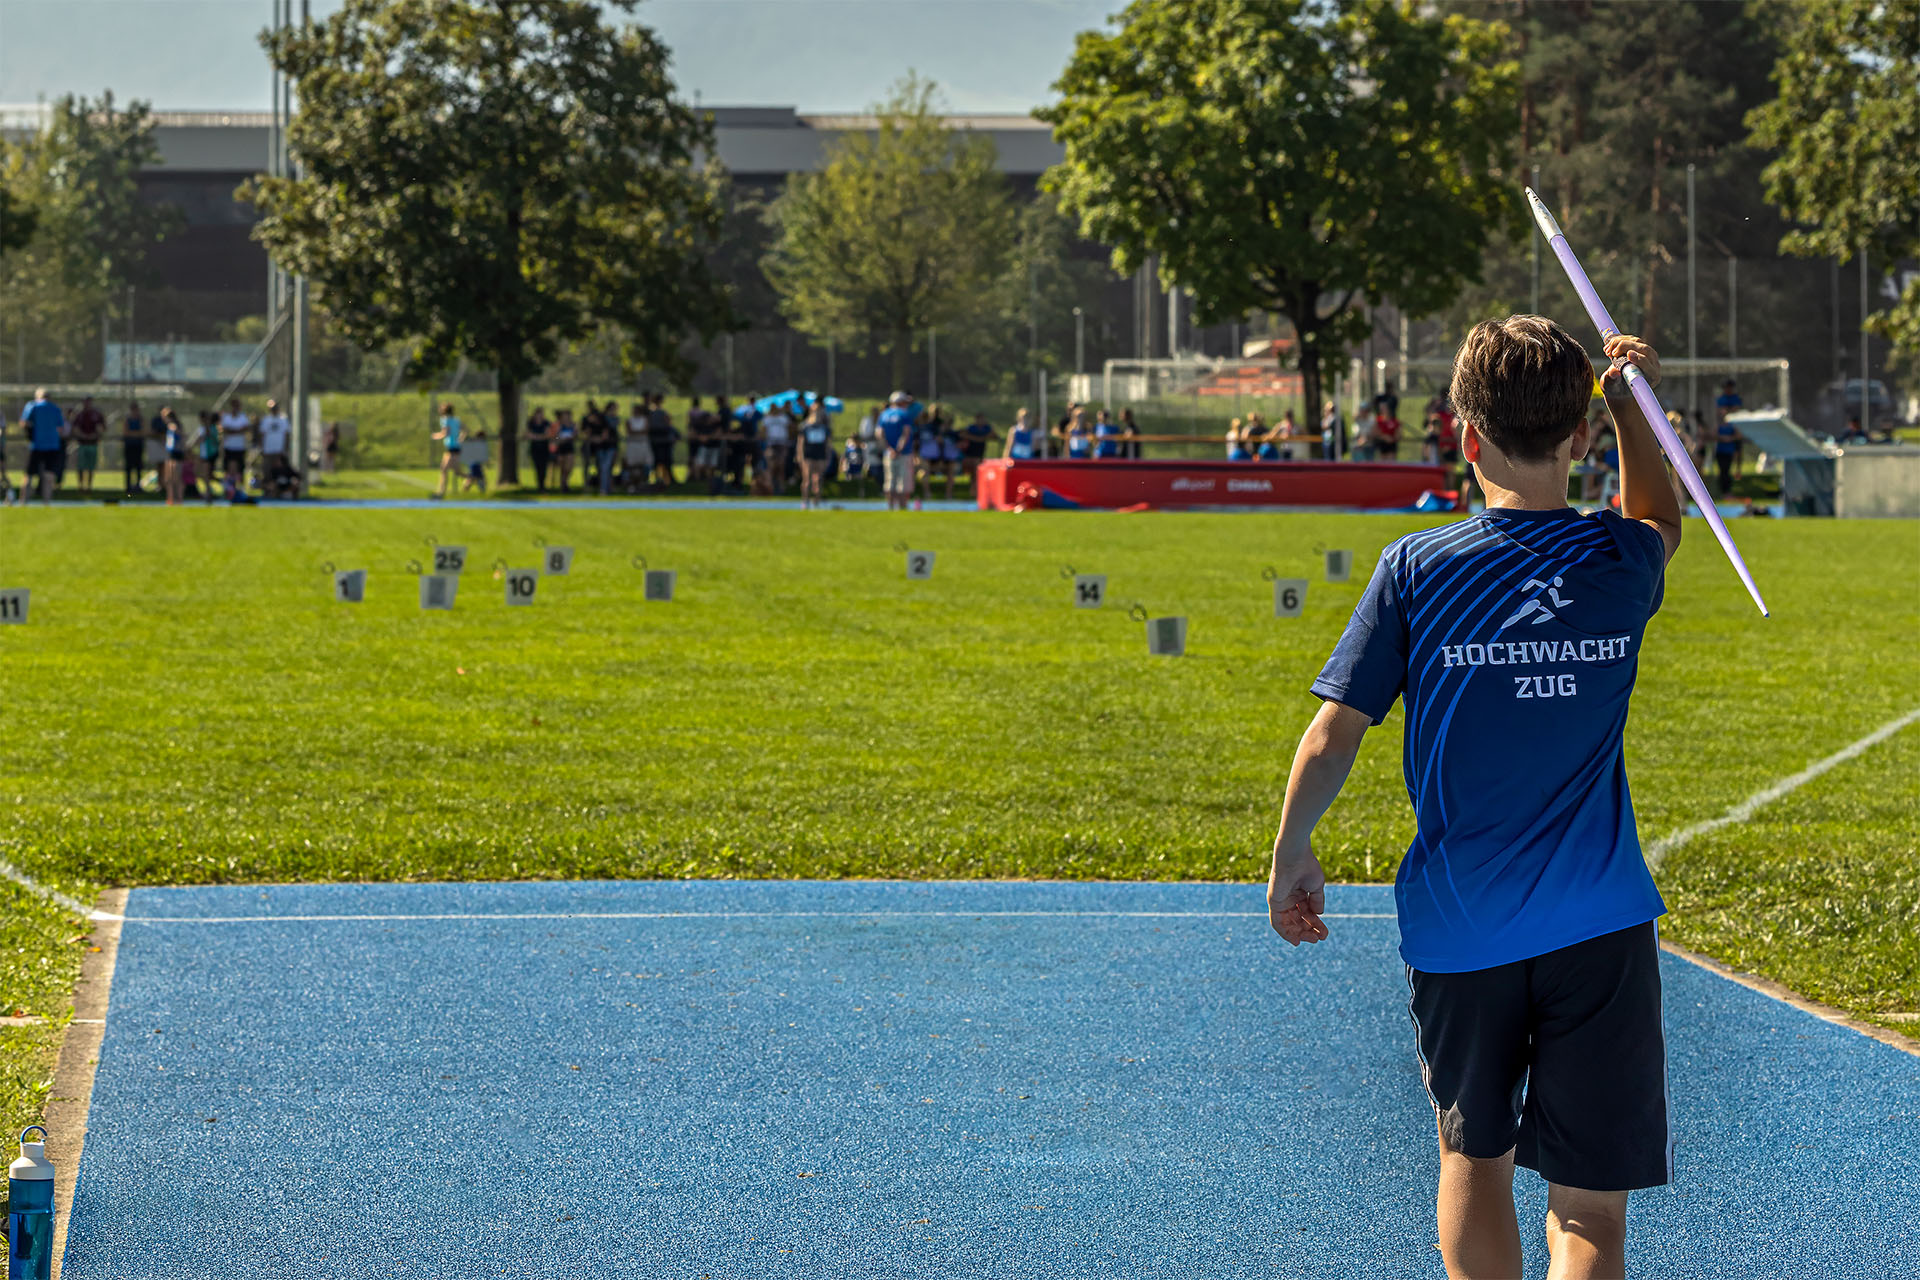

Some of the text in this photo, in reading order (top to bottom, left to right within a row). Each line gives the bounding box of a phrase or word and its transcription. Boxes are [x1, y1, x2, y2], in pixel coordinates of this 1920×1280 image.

[434, 550, 464, 571] 25
[549, 551, 565, 573] 8
[911, 555, 928, 576] 2
[508, 575, 535, 597] 10
[1076, 582, 1100, 603] 14
[0, 596, 20, 618] 11
[1281, 587, 1300, 611] 6
[1441, 635, 1631, 668] HOCHWACHT
[1514, 674, 1577, 698] ZUG
